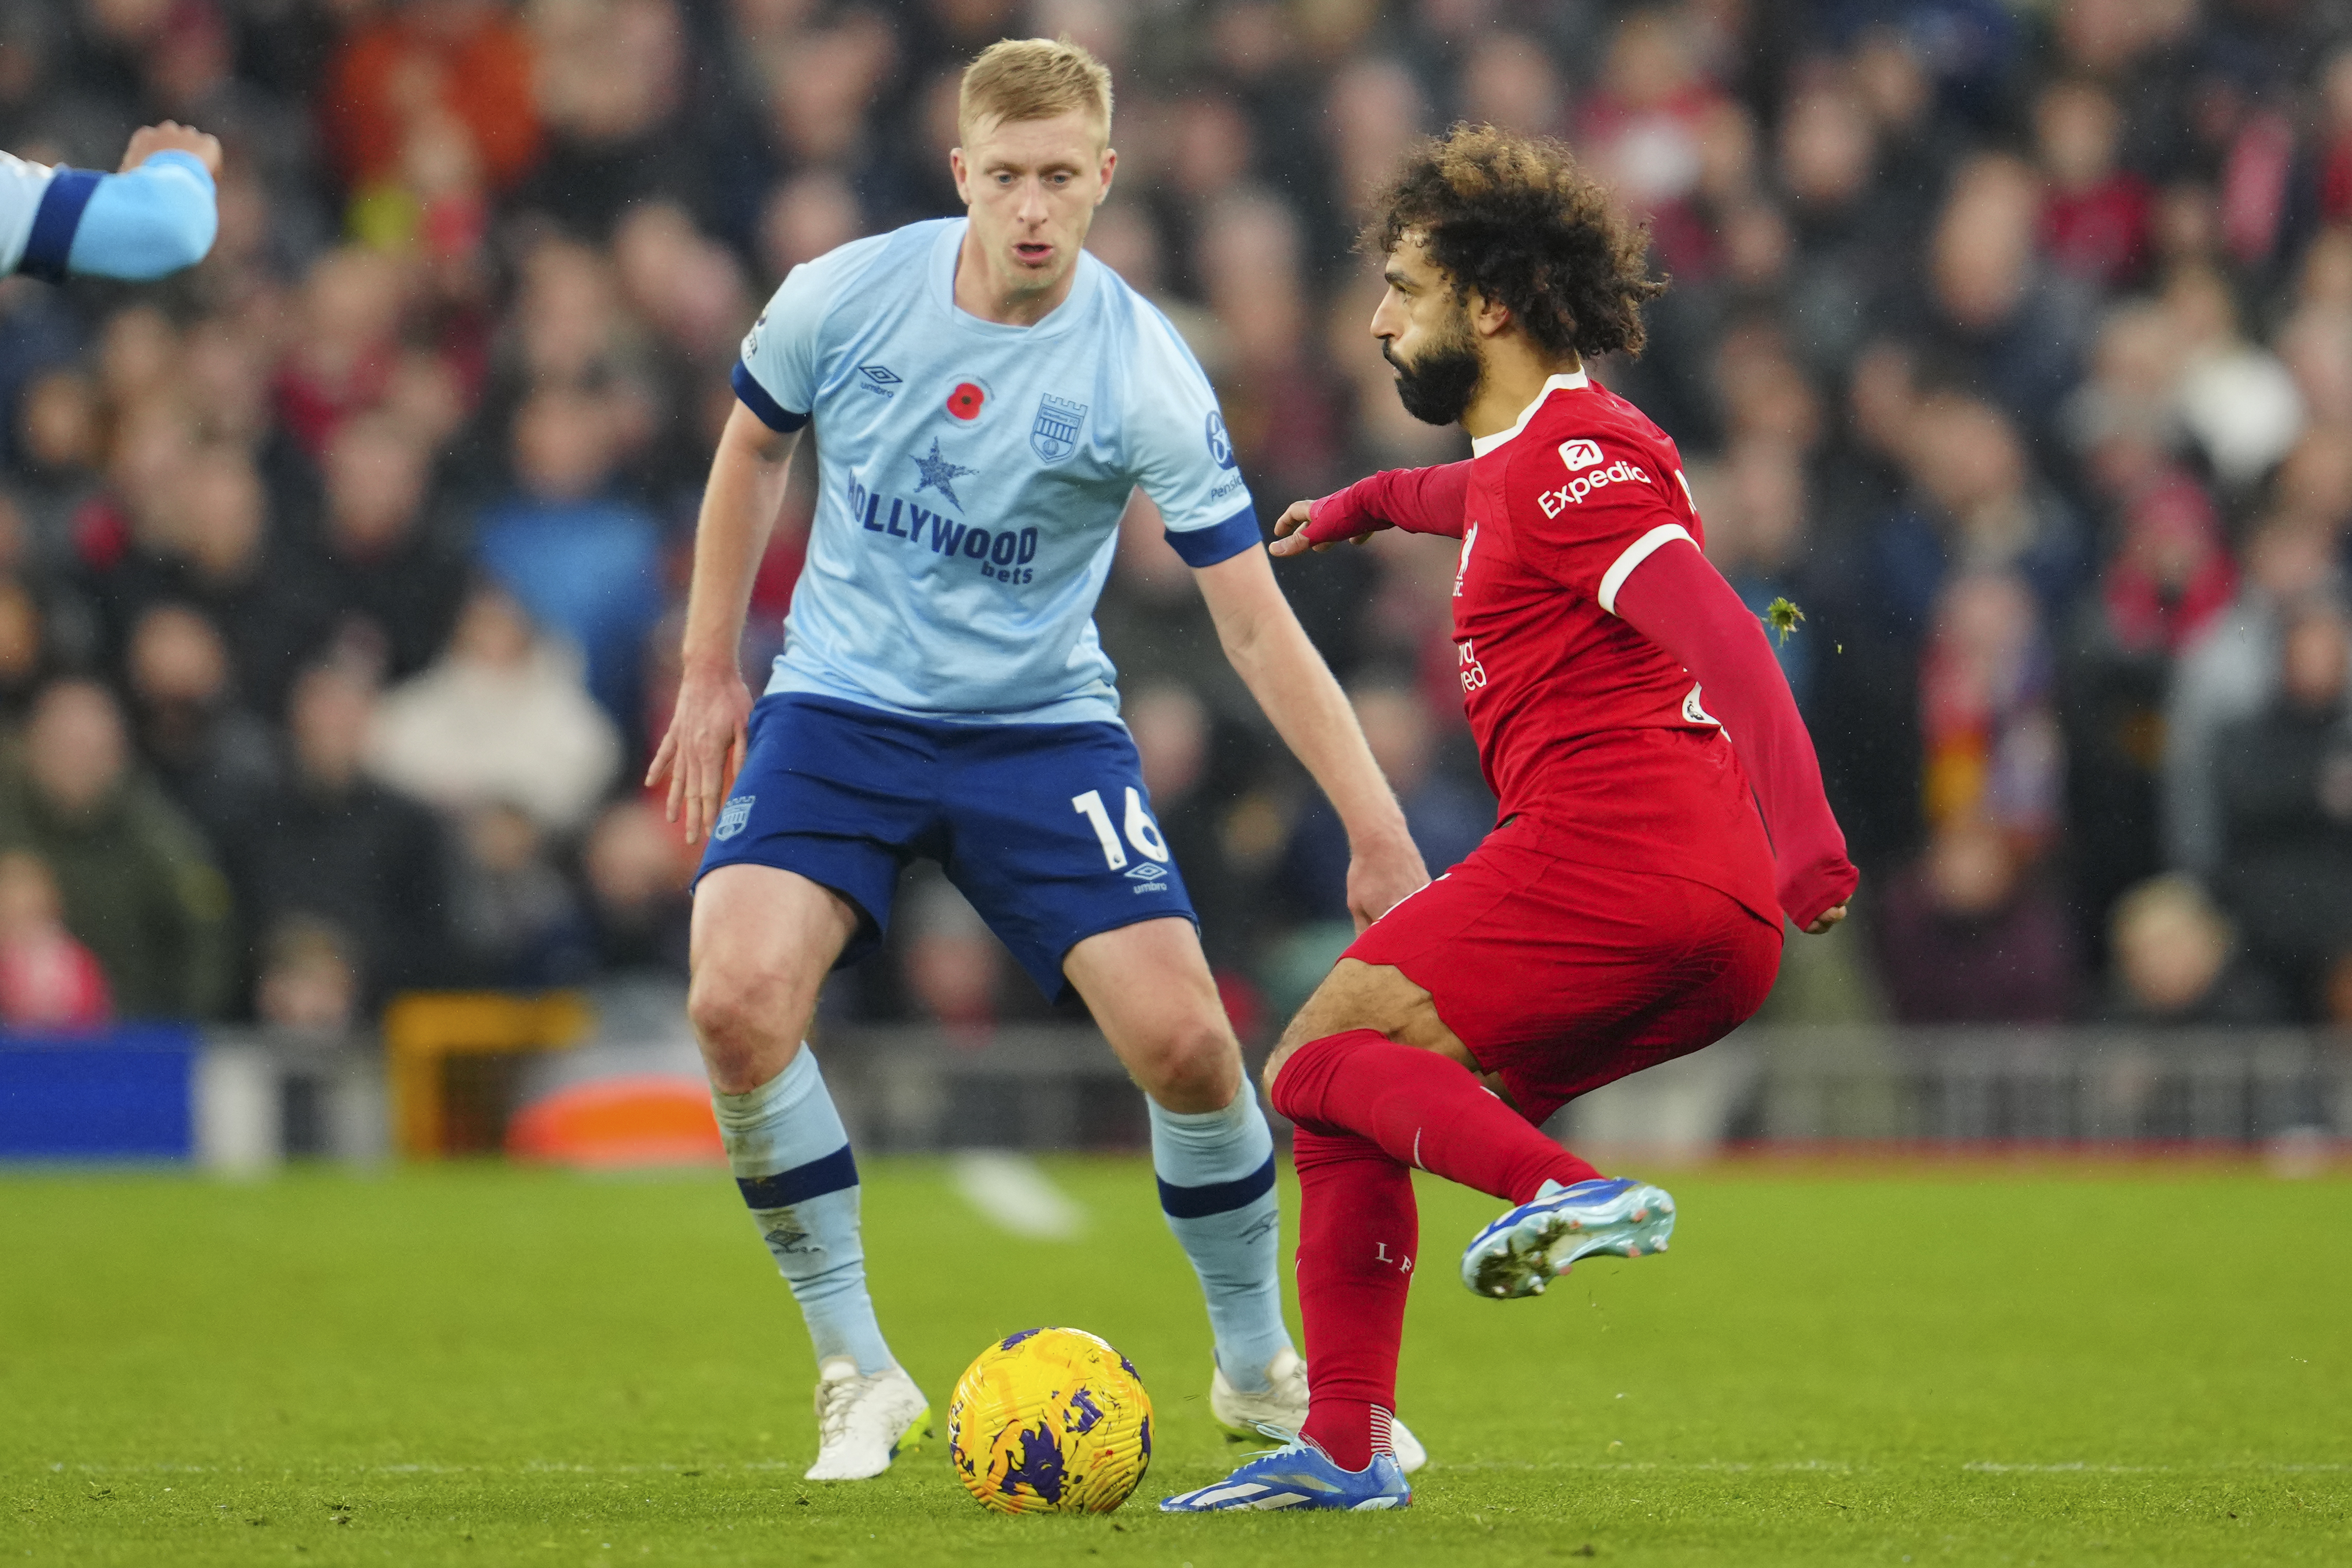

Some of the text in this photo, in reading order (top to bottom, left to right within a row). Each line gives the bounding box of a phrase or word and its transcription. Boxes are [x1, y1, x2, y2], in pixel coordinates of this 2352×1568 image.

[1537, 461, 1651, 520] Expedia
[981, 561, 1034, 585] bets
[1072, 786, 1169, 870] 16
[1133, 882, 1167, 895] umbro
